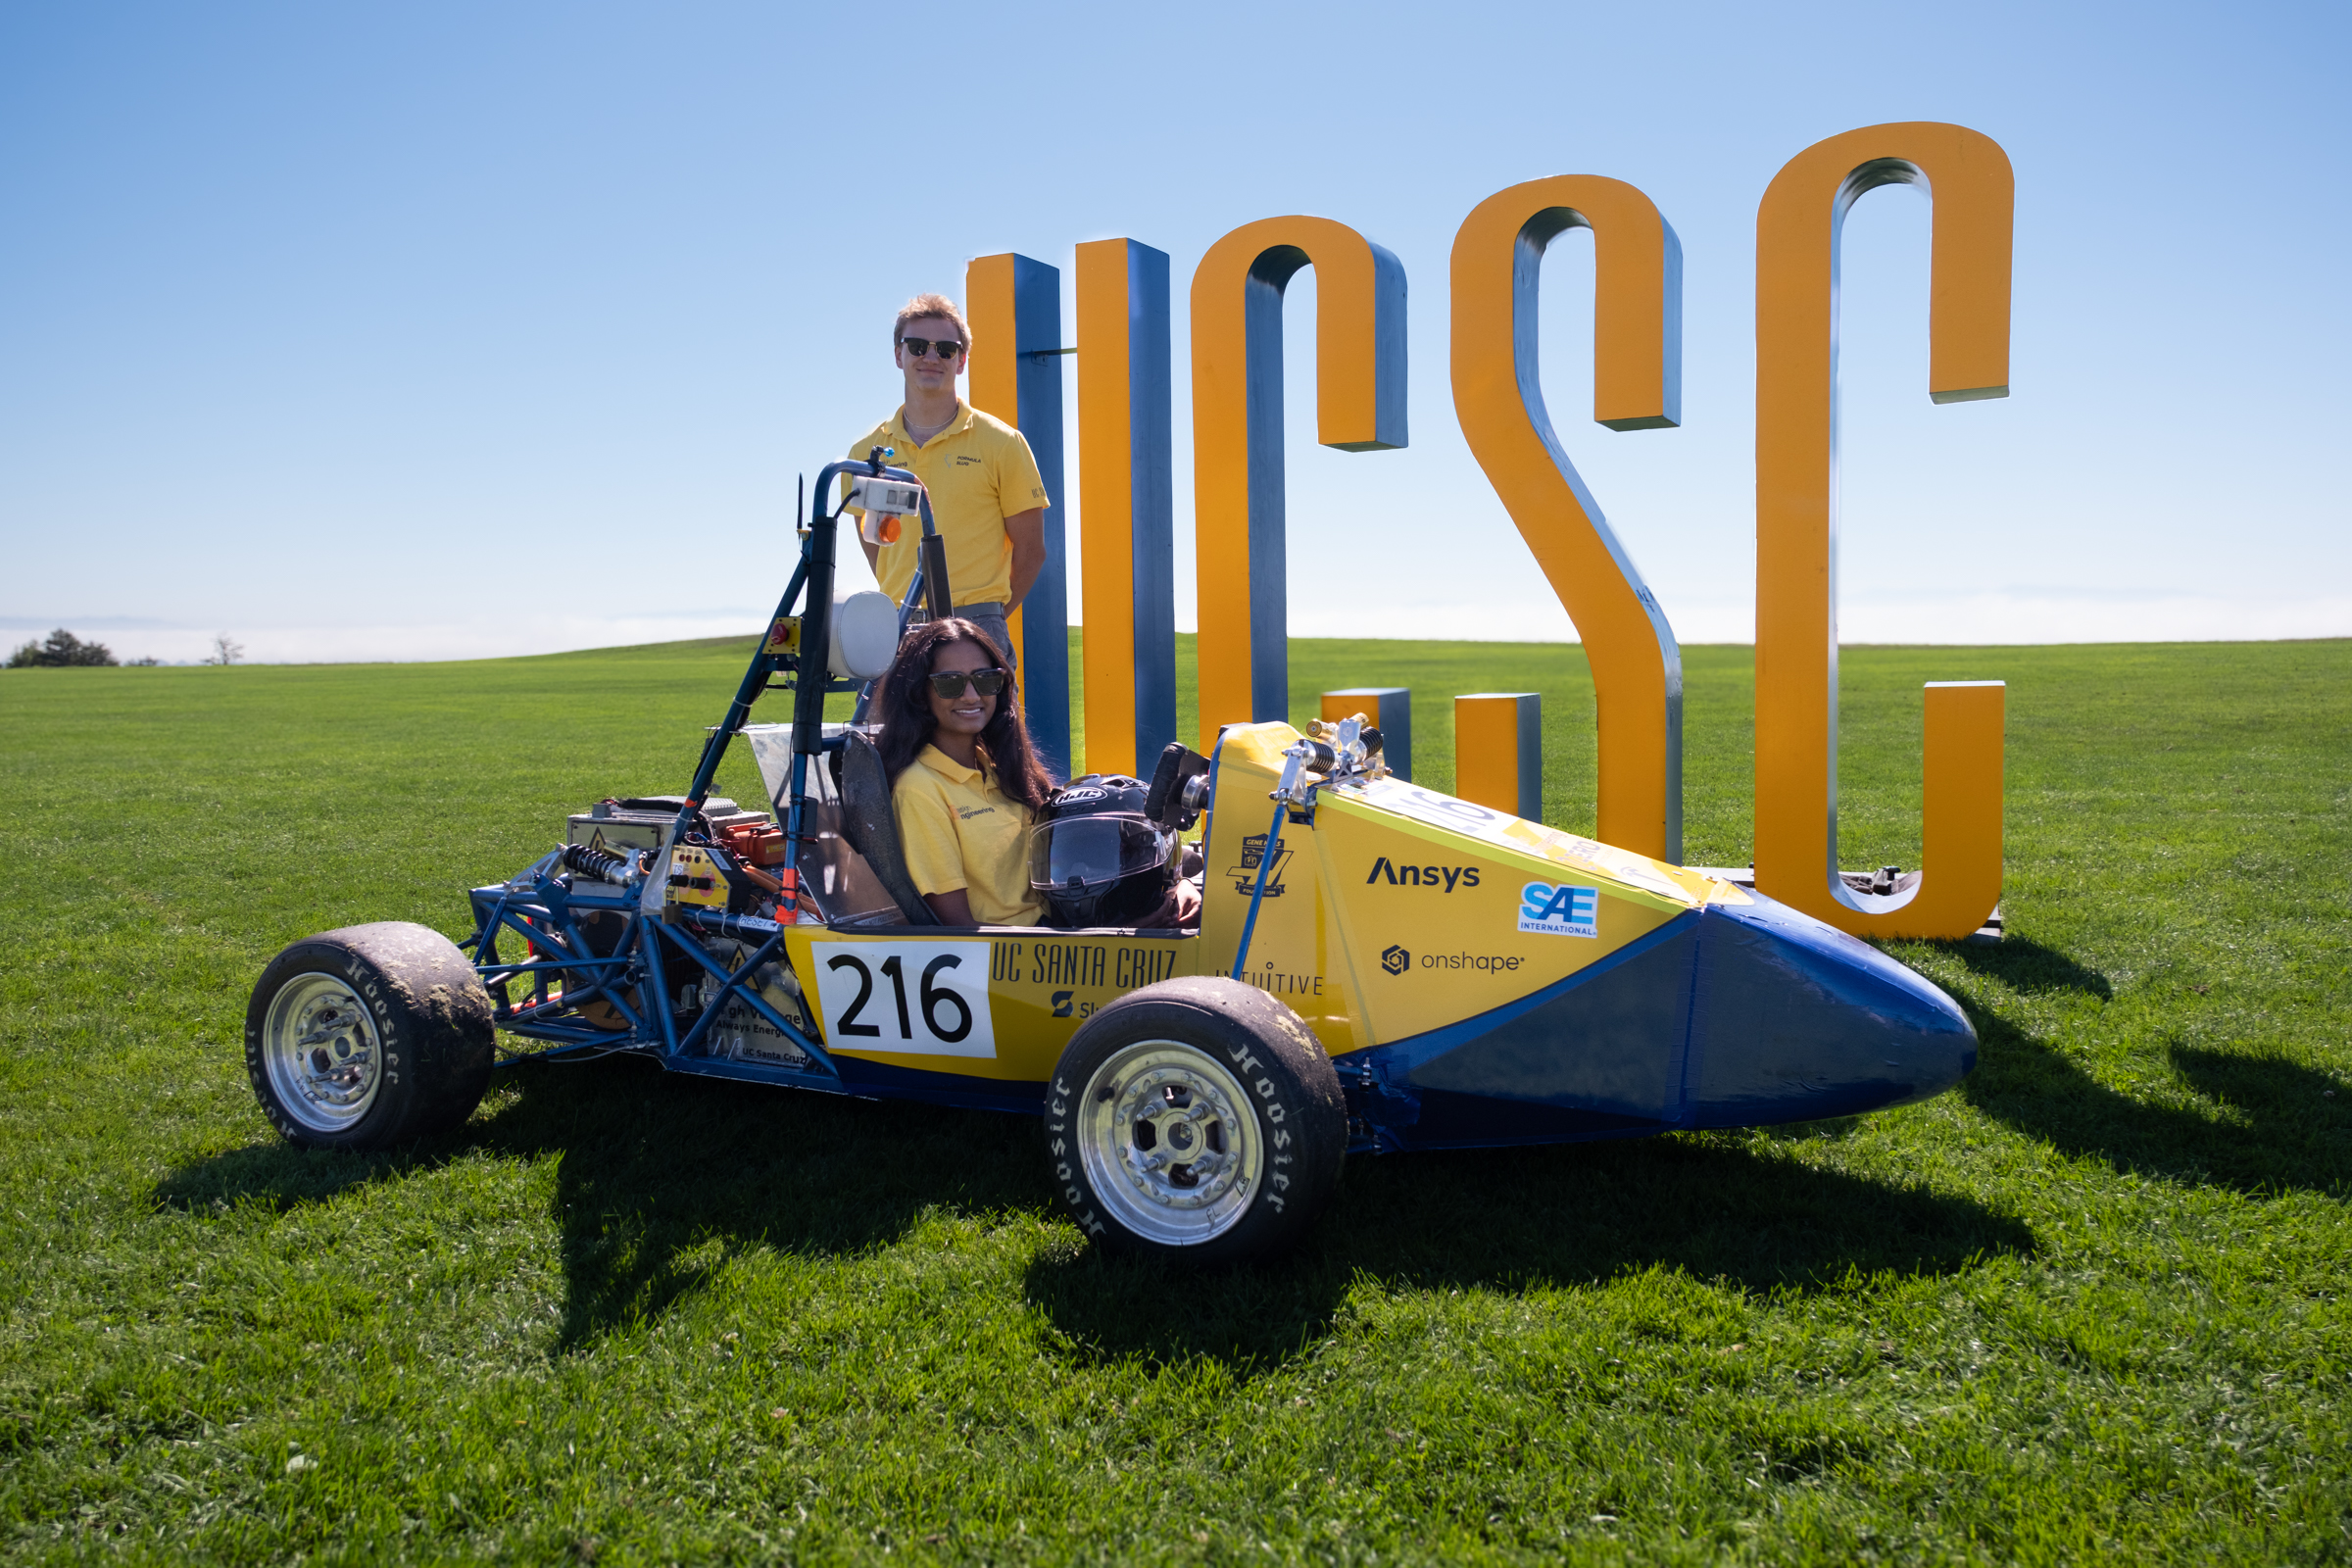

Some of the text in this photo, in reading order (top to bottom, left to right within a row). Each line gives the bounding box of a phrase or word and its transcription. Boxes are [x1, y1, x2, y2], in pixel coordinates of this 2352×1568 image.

[965, 121, 2015, 939] UCSC
[959, 807, 996, 819] ngineering
[1058, 790, 1100, 804] HJC
[1384, 791, 1495, 833] 216
[1366, 857, 1480, 893] Ansys
[1522, 884, 1595, 925] SAE
[1520, 922, 1592, 936] INTERNATIONAL
[993, 942, 1021, 982] UC
[1032, 944, 1106, 987] SANTA
[1421, 952, 1520, 975] onshape
[827, 954, 972, 1043] 216
[715, 1020, 751, 1032] Always
[757, 1049, 781, 1059] Santa
[1228, 1044, 1292, 1214] Hoosier
